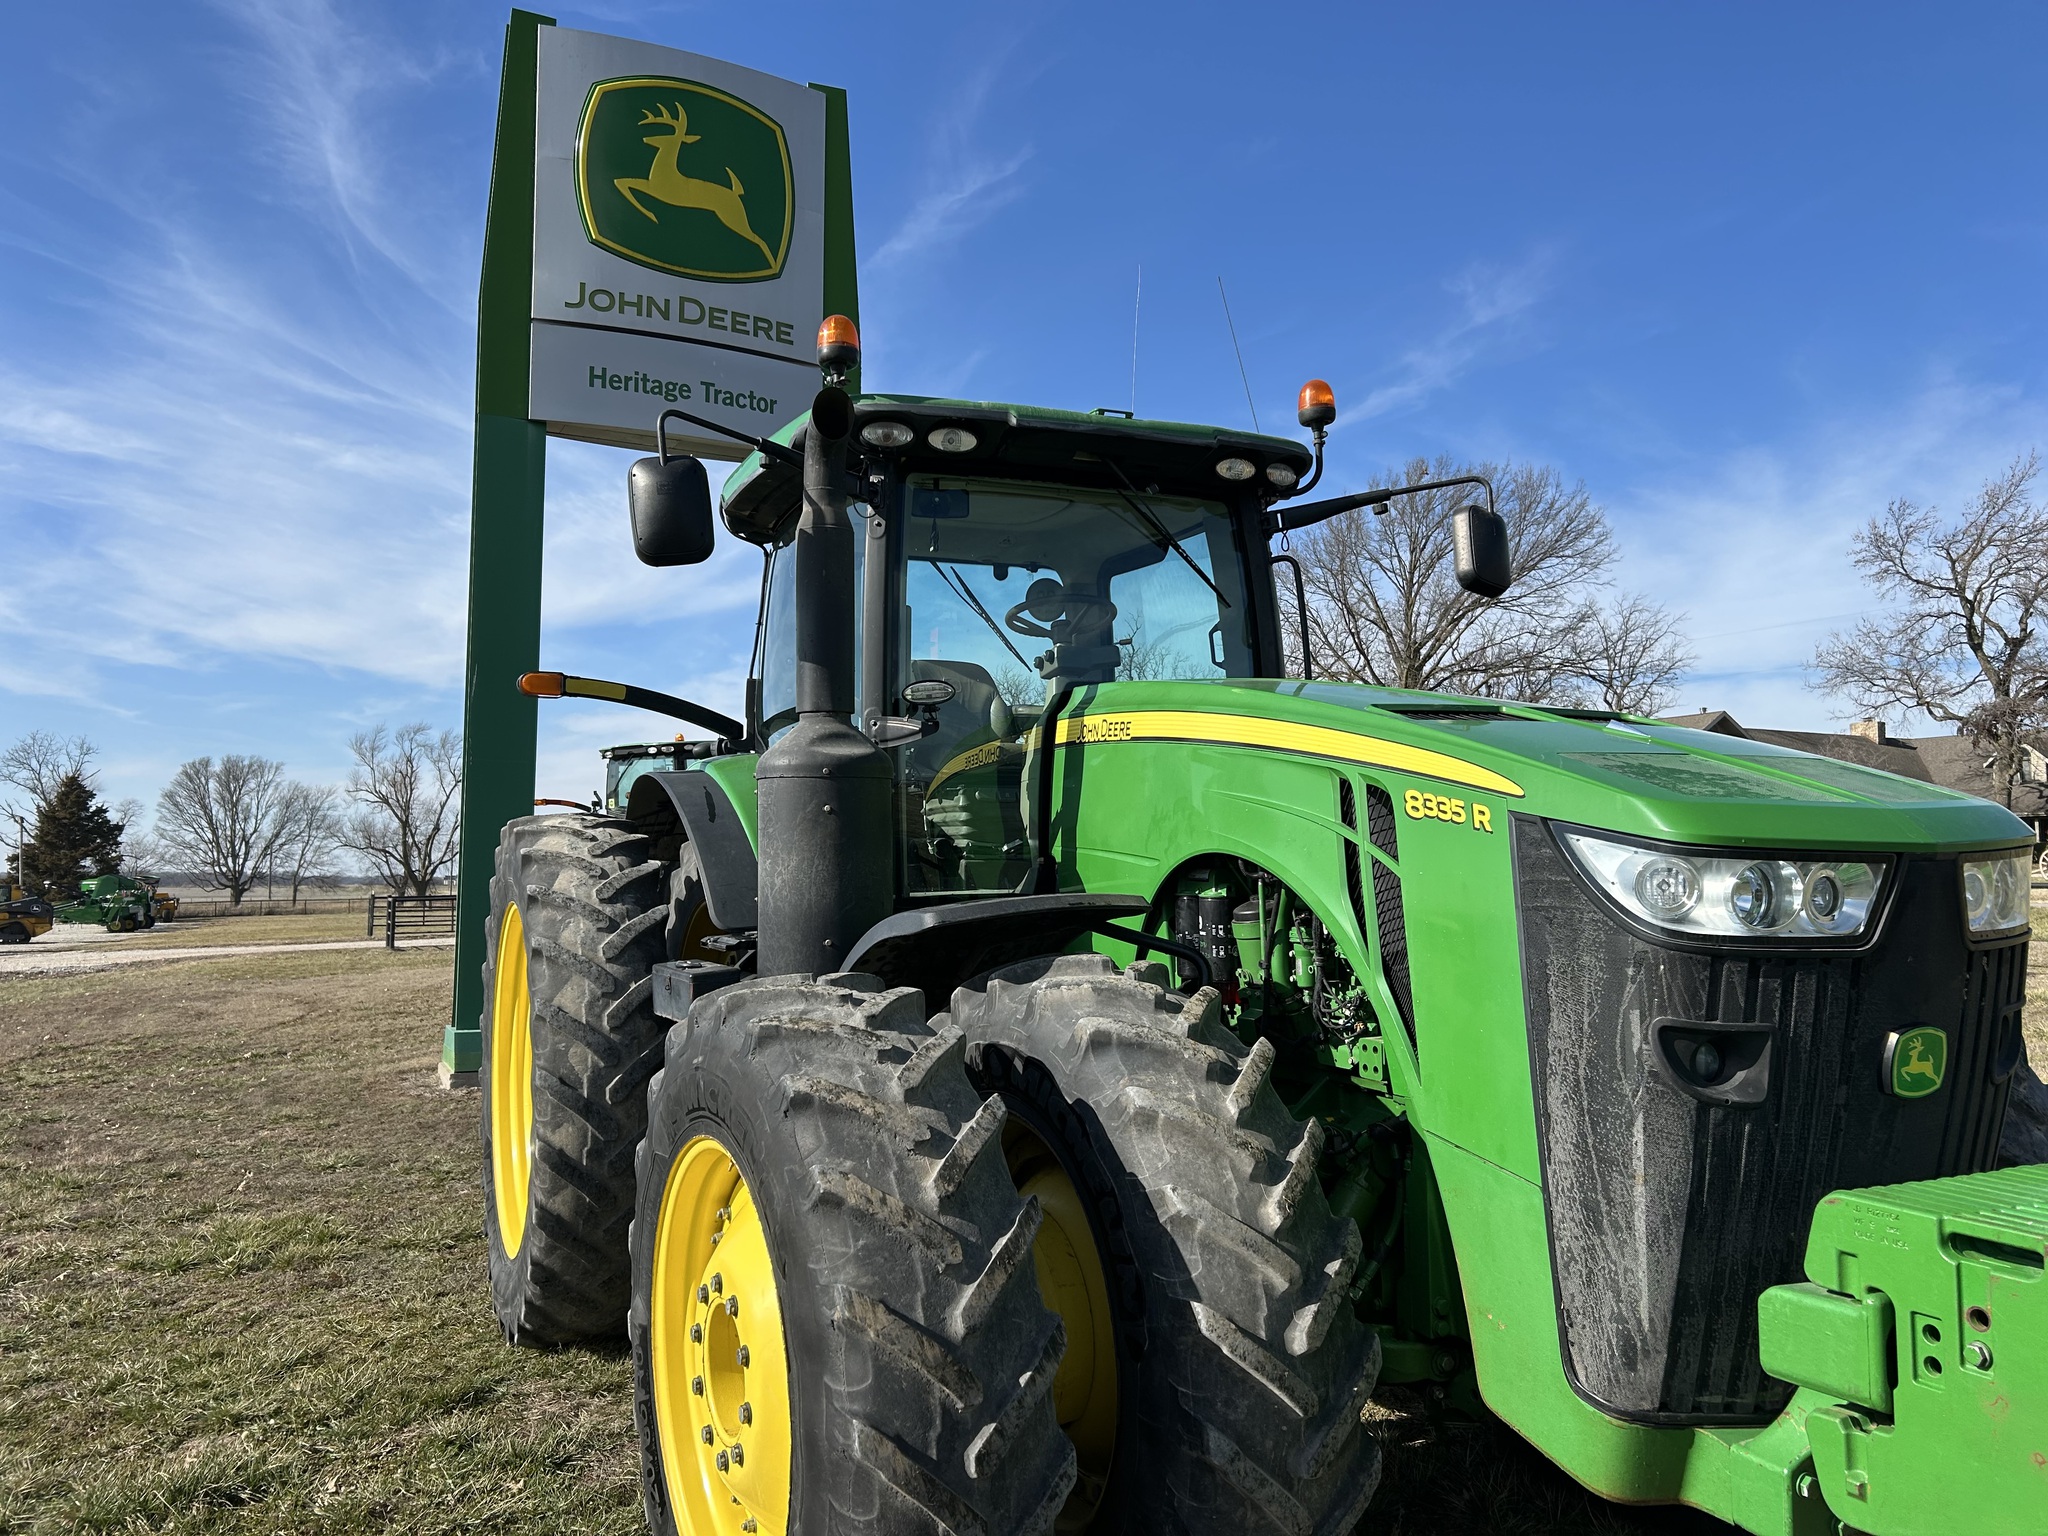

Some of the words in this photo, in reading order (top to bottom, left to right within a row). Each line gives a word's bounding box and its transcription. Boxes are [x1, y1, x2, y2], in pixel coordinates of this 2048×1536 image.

[564, 281, 671, 321] JOHN
[678, 295, 795, 346] DEERE
[588, 365, 692, 403] Heritage
[700, 380, 778, 415] Tractor
[1076, 720, 1100, 742] JOHN
[1100, 718, 1132, 740] DEERE
[1404, 789, 1467, 825] 8335
[1471, 802, 1494, 834] R
[1892, 1239, 1909, 1250] USA
